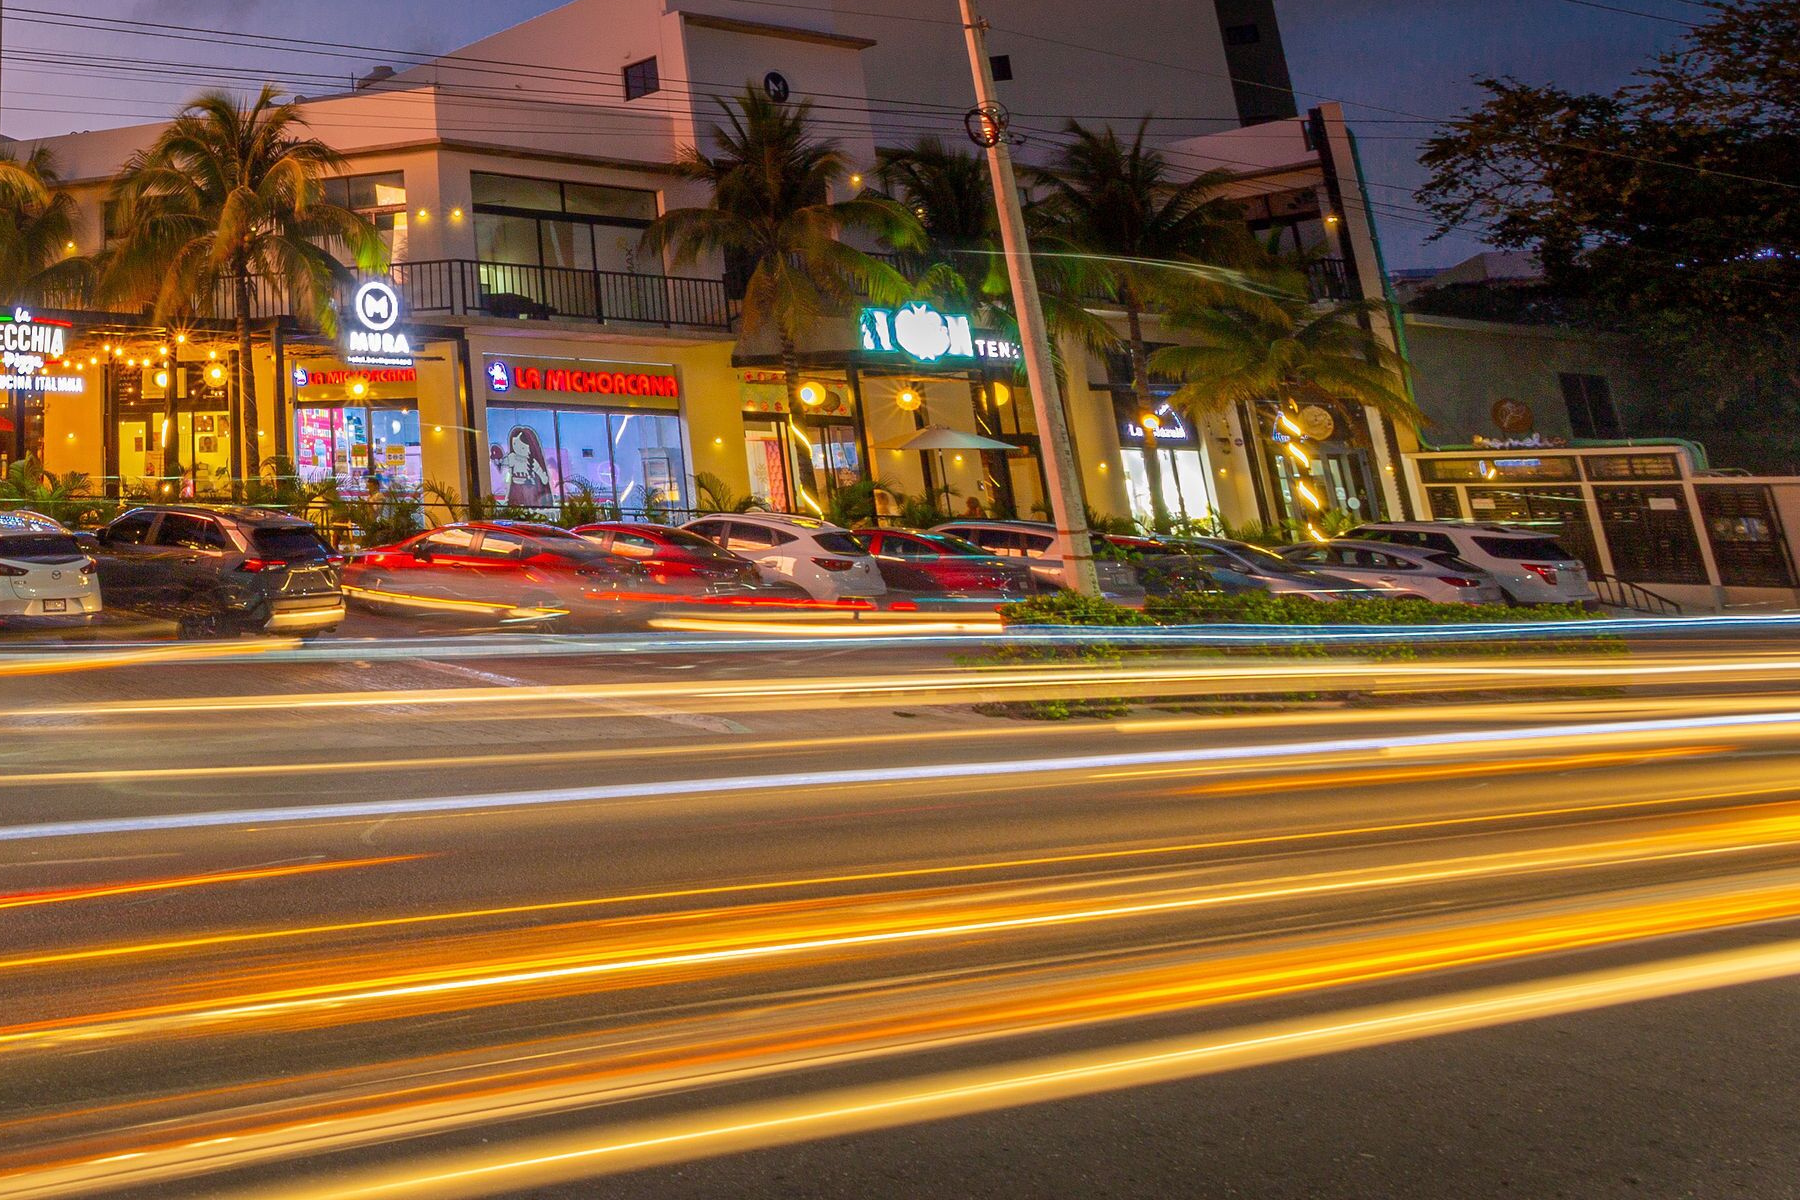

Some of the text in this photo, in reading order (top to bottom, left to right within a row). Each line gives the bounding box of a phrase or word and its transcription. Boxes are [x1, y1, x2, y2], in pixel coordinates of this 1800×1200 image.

[349, 332, 410, 353] MURA
[307, 371, 325, 384] LA
[515, 366, 679, 397] LA MICHOACANA
